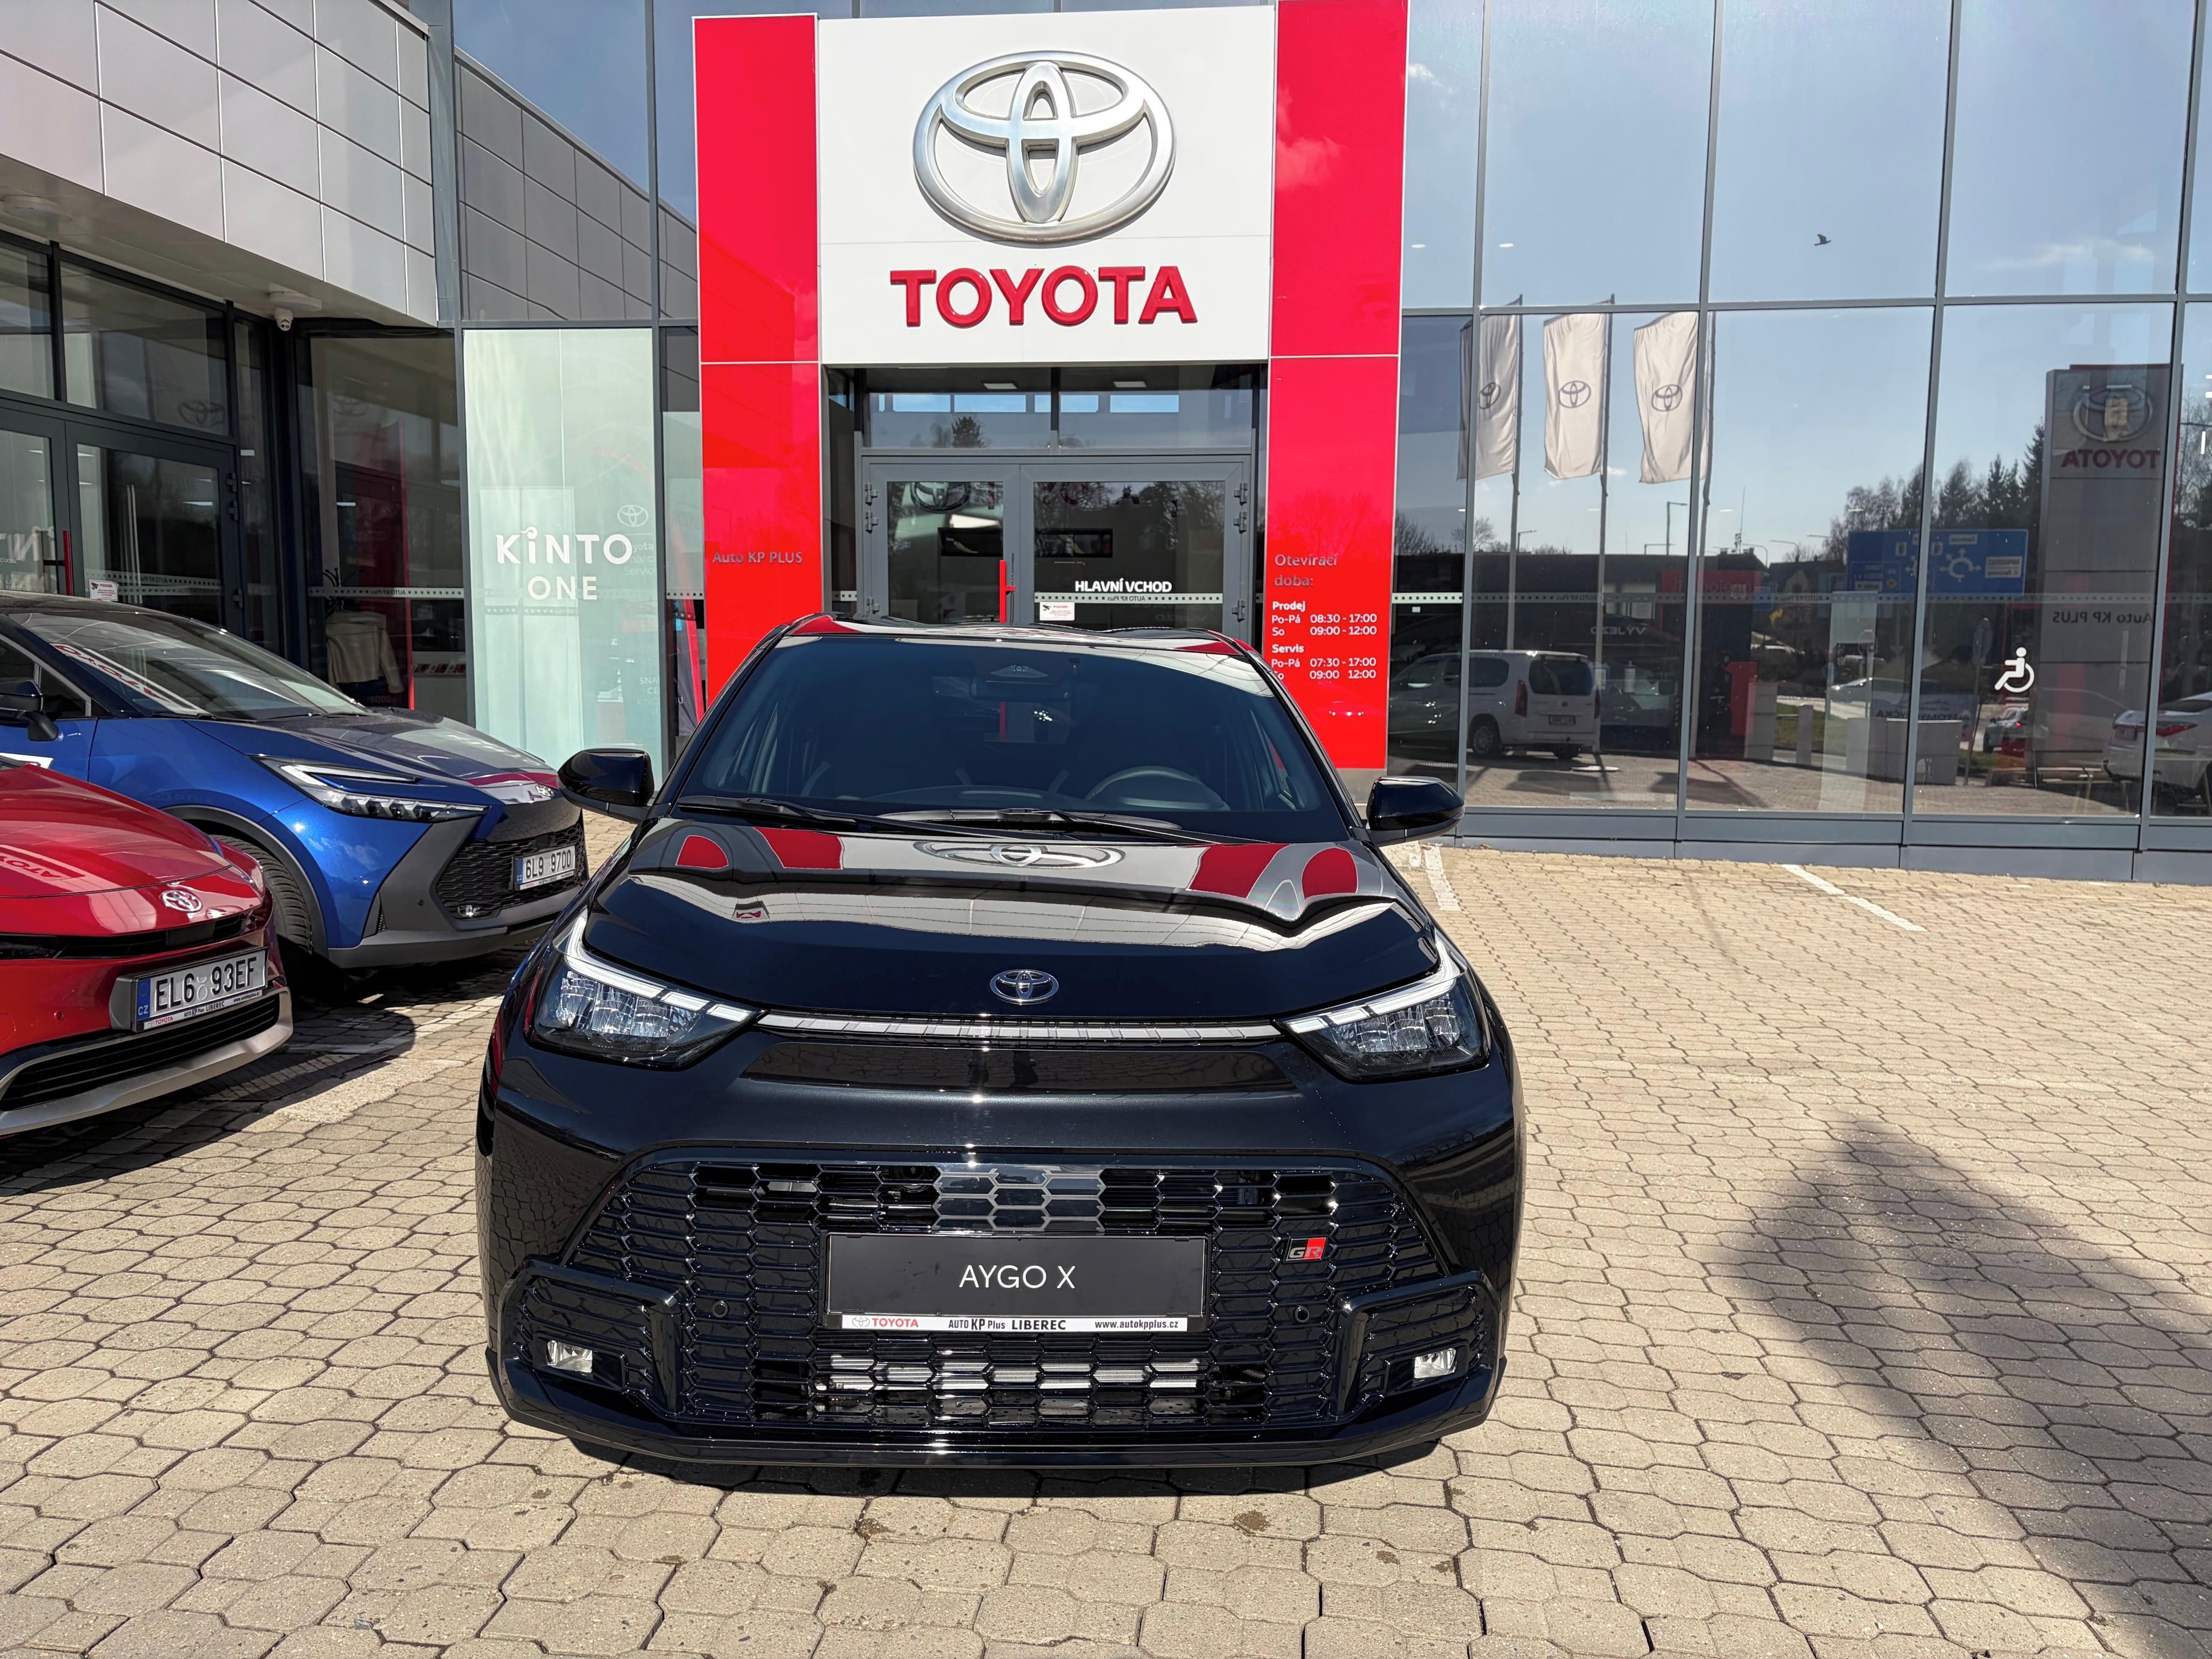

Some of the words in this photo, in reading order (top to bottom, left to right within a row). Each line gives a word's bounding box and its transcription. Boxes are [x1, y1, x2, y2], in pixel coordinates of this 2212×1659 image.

[890, 266, 1198, 329] TOYOTA
[632, 542, 654, 553] yota
[713, 552, 744, 563] Auto
[748, 552, 765, 563] KP
[770, 552, 803, 563] PLUS
[1274, 554, 1338, 567] Otevírací
[1075, 578, 1124, 592] HLAVNÍ
[1126, 581, 1172, 592] VCHOD
[1274, 575, 1313, 587] doba:
[528, 576, 597, 600] ONE
[1273, 601, 1306, 612] Prodej
[1272, 614, 1301, 624] Po-Pá
[1310, 614, 1340, 623] 08:30
[1349, 613, 1377, 623] 17:00
[1272, 627, 1285, 636] So
[1310, 626, 1340, 636] 09:00
[1348, 626, 1377, 635] 12:00
[1272, 644, 1304, 653] Servis
[1271, 658, 1300, 667] Po-Pá
[1310, 658, 1339, 667] 07:30
[1348, 658, 1377, 667] 17:00
[1310, 670, 1339, 679] 09:00
[1348, 670, 1376, 679] 12:00
[525, 857, 543, 879] 6L9
[551, 849, 571, 872] 9700
[138, 1005, 149, 1015] CZ
[155, 973, 194, 1011] EL6
[211, 957, 257, 995] 93EF
[155, 1016, 173, 1025] TOYOTA
[206, 1001, 225, 1011] LIBEREC
[1289, 1246, 1321, 1258] GR
[959, 1265, 1047, 1289] AYGO
[1056, 1265, 1076, 1289] X
[872, 1318, 919, 1327] TOYOTA
[949, 1319, 969, 1328] AUTO
[972, 1318, 985, 1330] KP
[988, 1320, 1006, 1329] Plus
[1011, 1320, 1066, 1330] LIBEREC
[1095, 1319, 1178, 1331] www.autokpplus.cz
